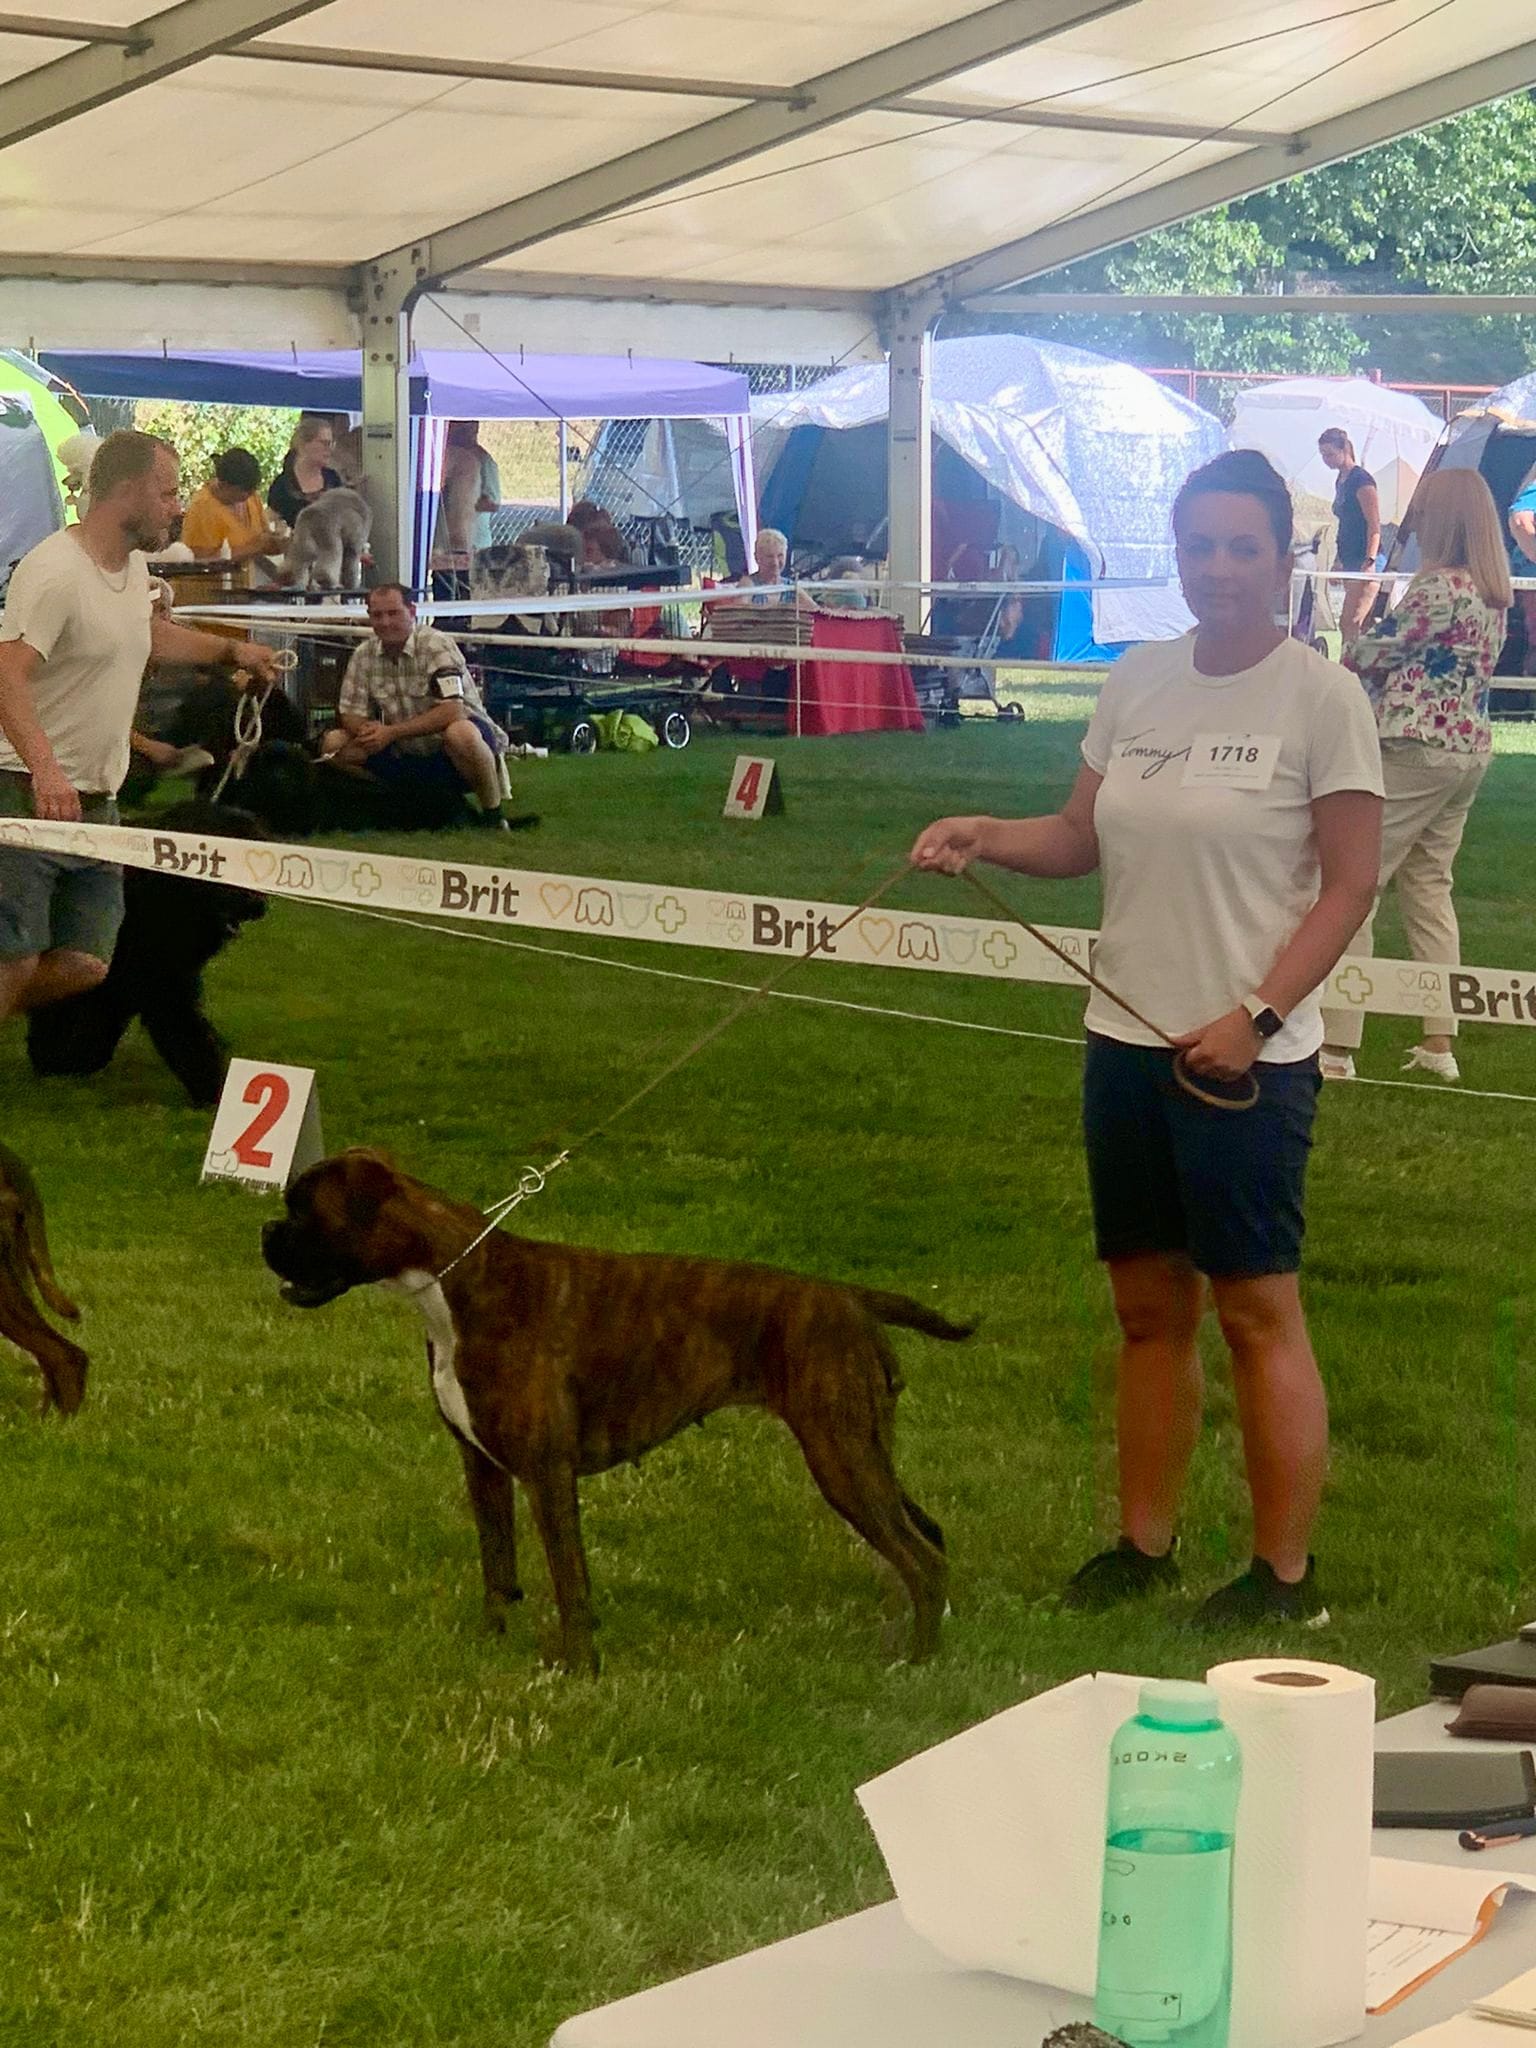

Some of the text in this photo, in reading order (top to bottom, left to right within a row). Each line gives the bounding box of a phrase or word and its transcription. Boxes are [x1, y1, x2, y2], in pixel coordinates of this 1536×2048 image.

[1210, 746, 1260, 763] 1718
[735, 762, 764, 811] 4
[153, 836, 227, 878] Brit
[440, 868, 520, 917] Brit
[752, 903, 838, 953] Brit
[231, 1072, 290, 1169] 2
